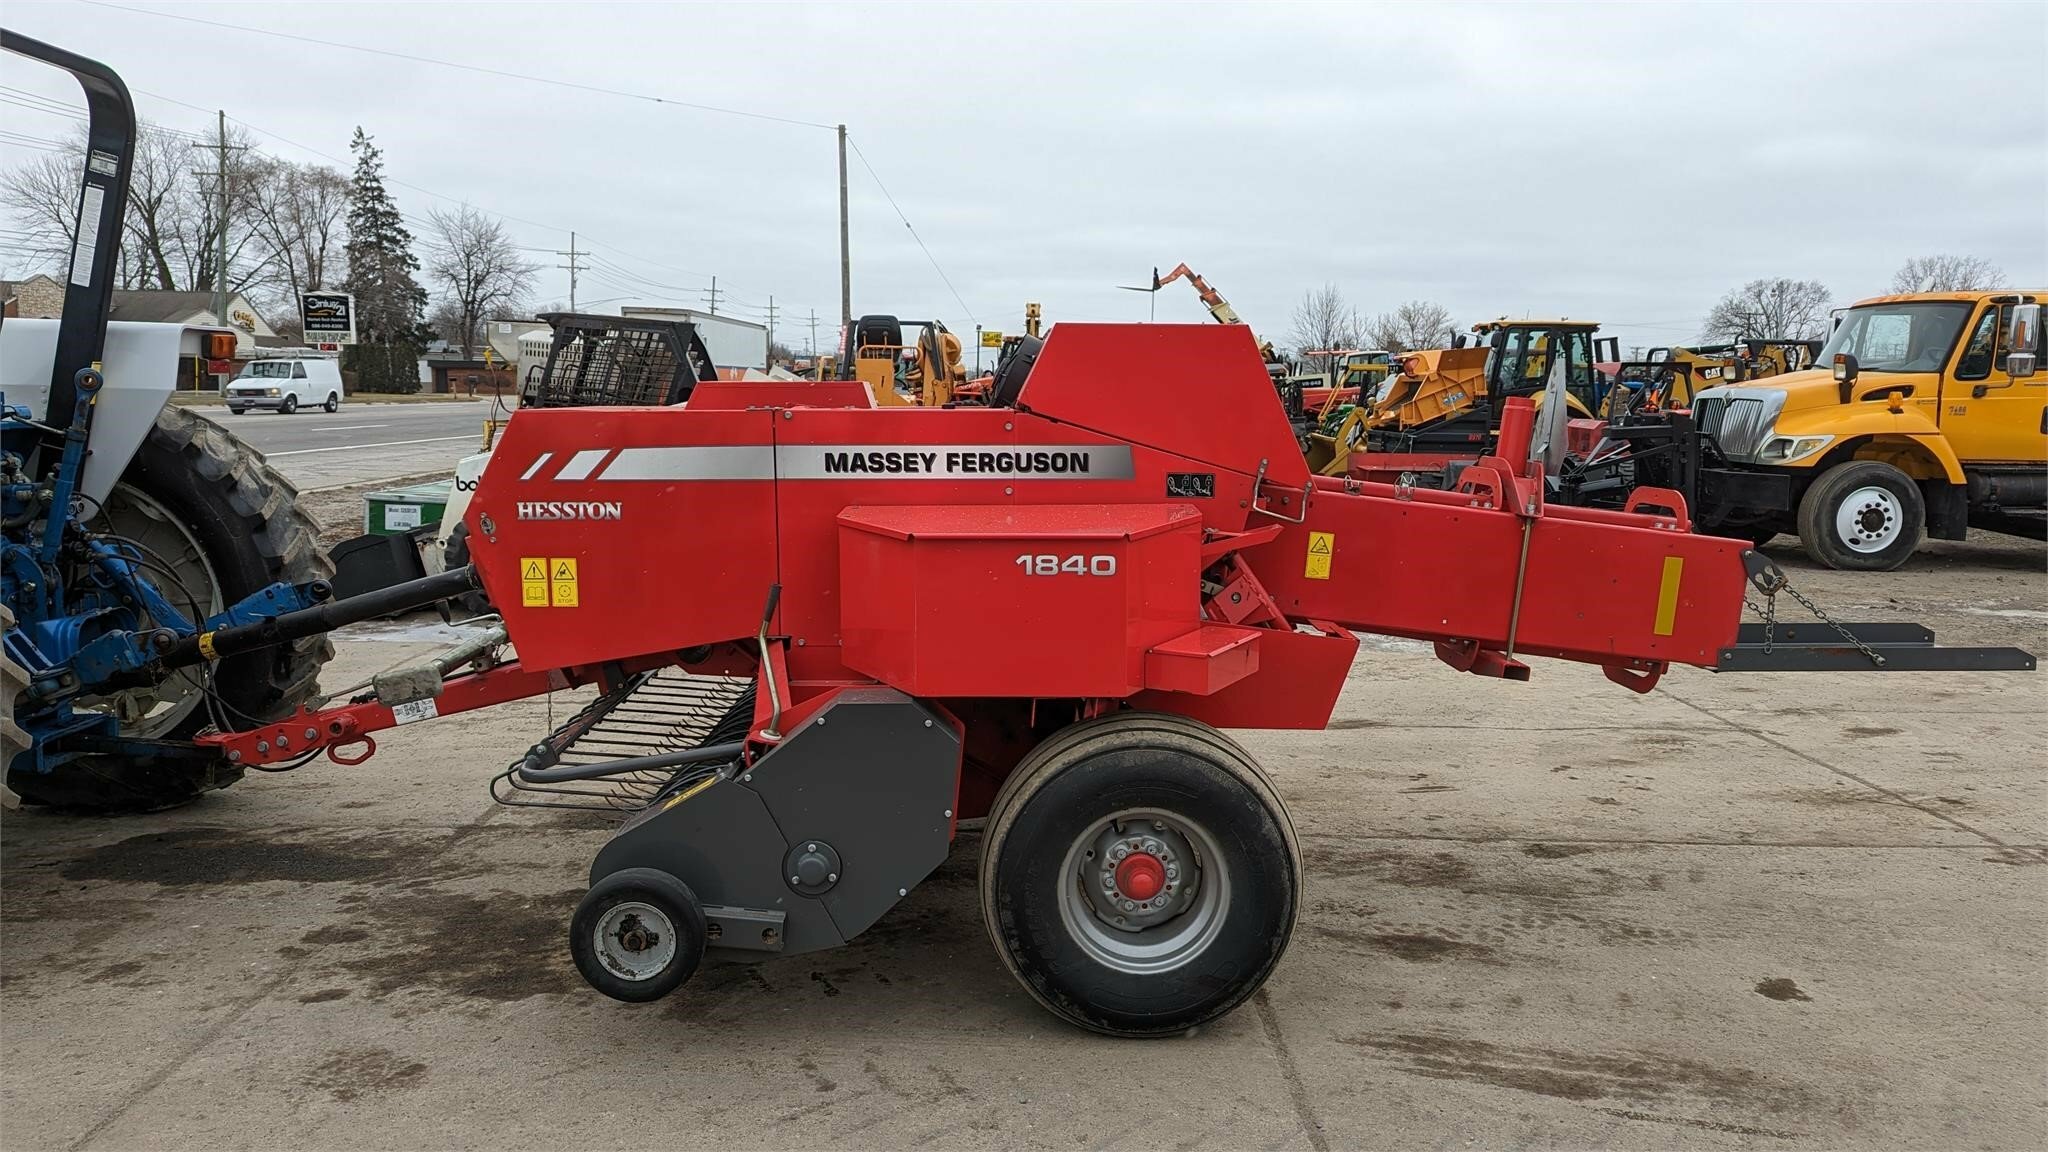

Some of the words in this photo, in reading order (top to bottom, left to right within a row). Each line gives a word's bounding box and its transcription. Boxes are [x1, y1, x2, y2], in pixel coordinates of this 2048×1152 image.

[335, 304, 346, 316] 21
[1705, 367, 1721, 380] CAT
[824, 452, 938, 474] MASSEY
[946, 452, 1090, 474] FERGUSON
[516, 501, 622, 520] HESSTON
[1015, 554, 1117, 576] 1840
